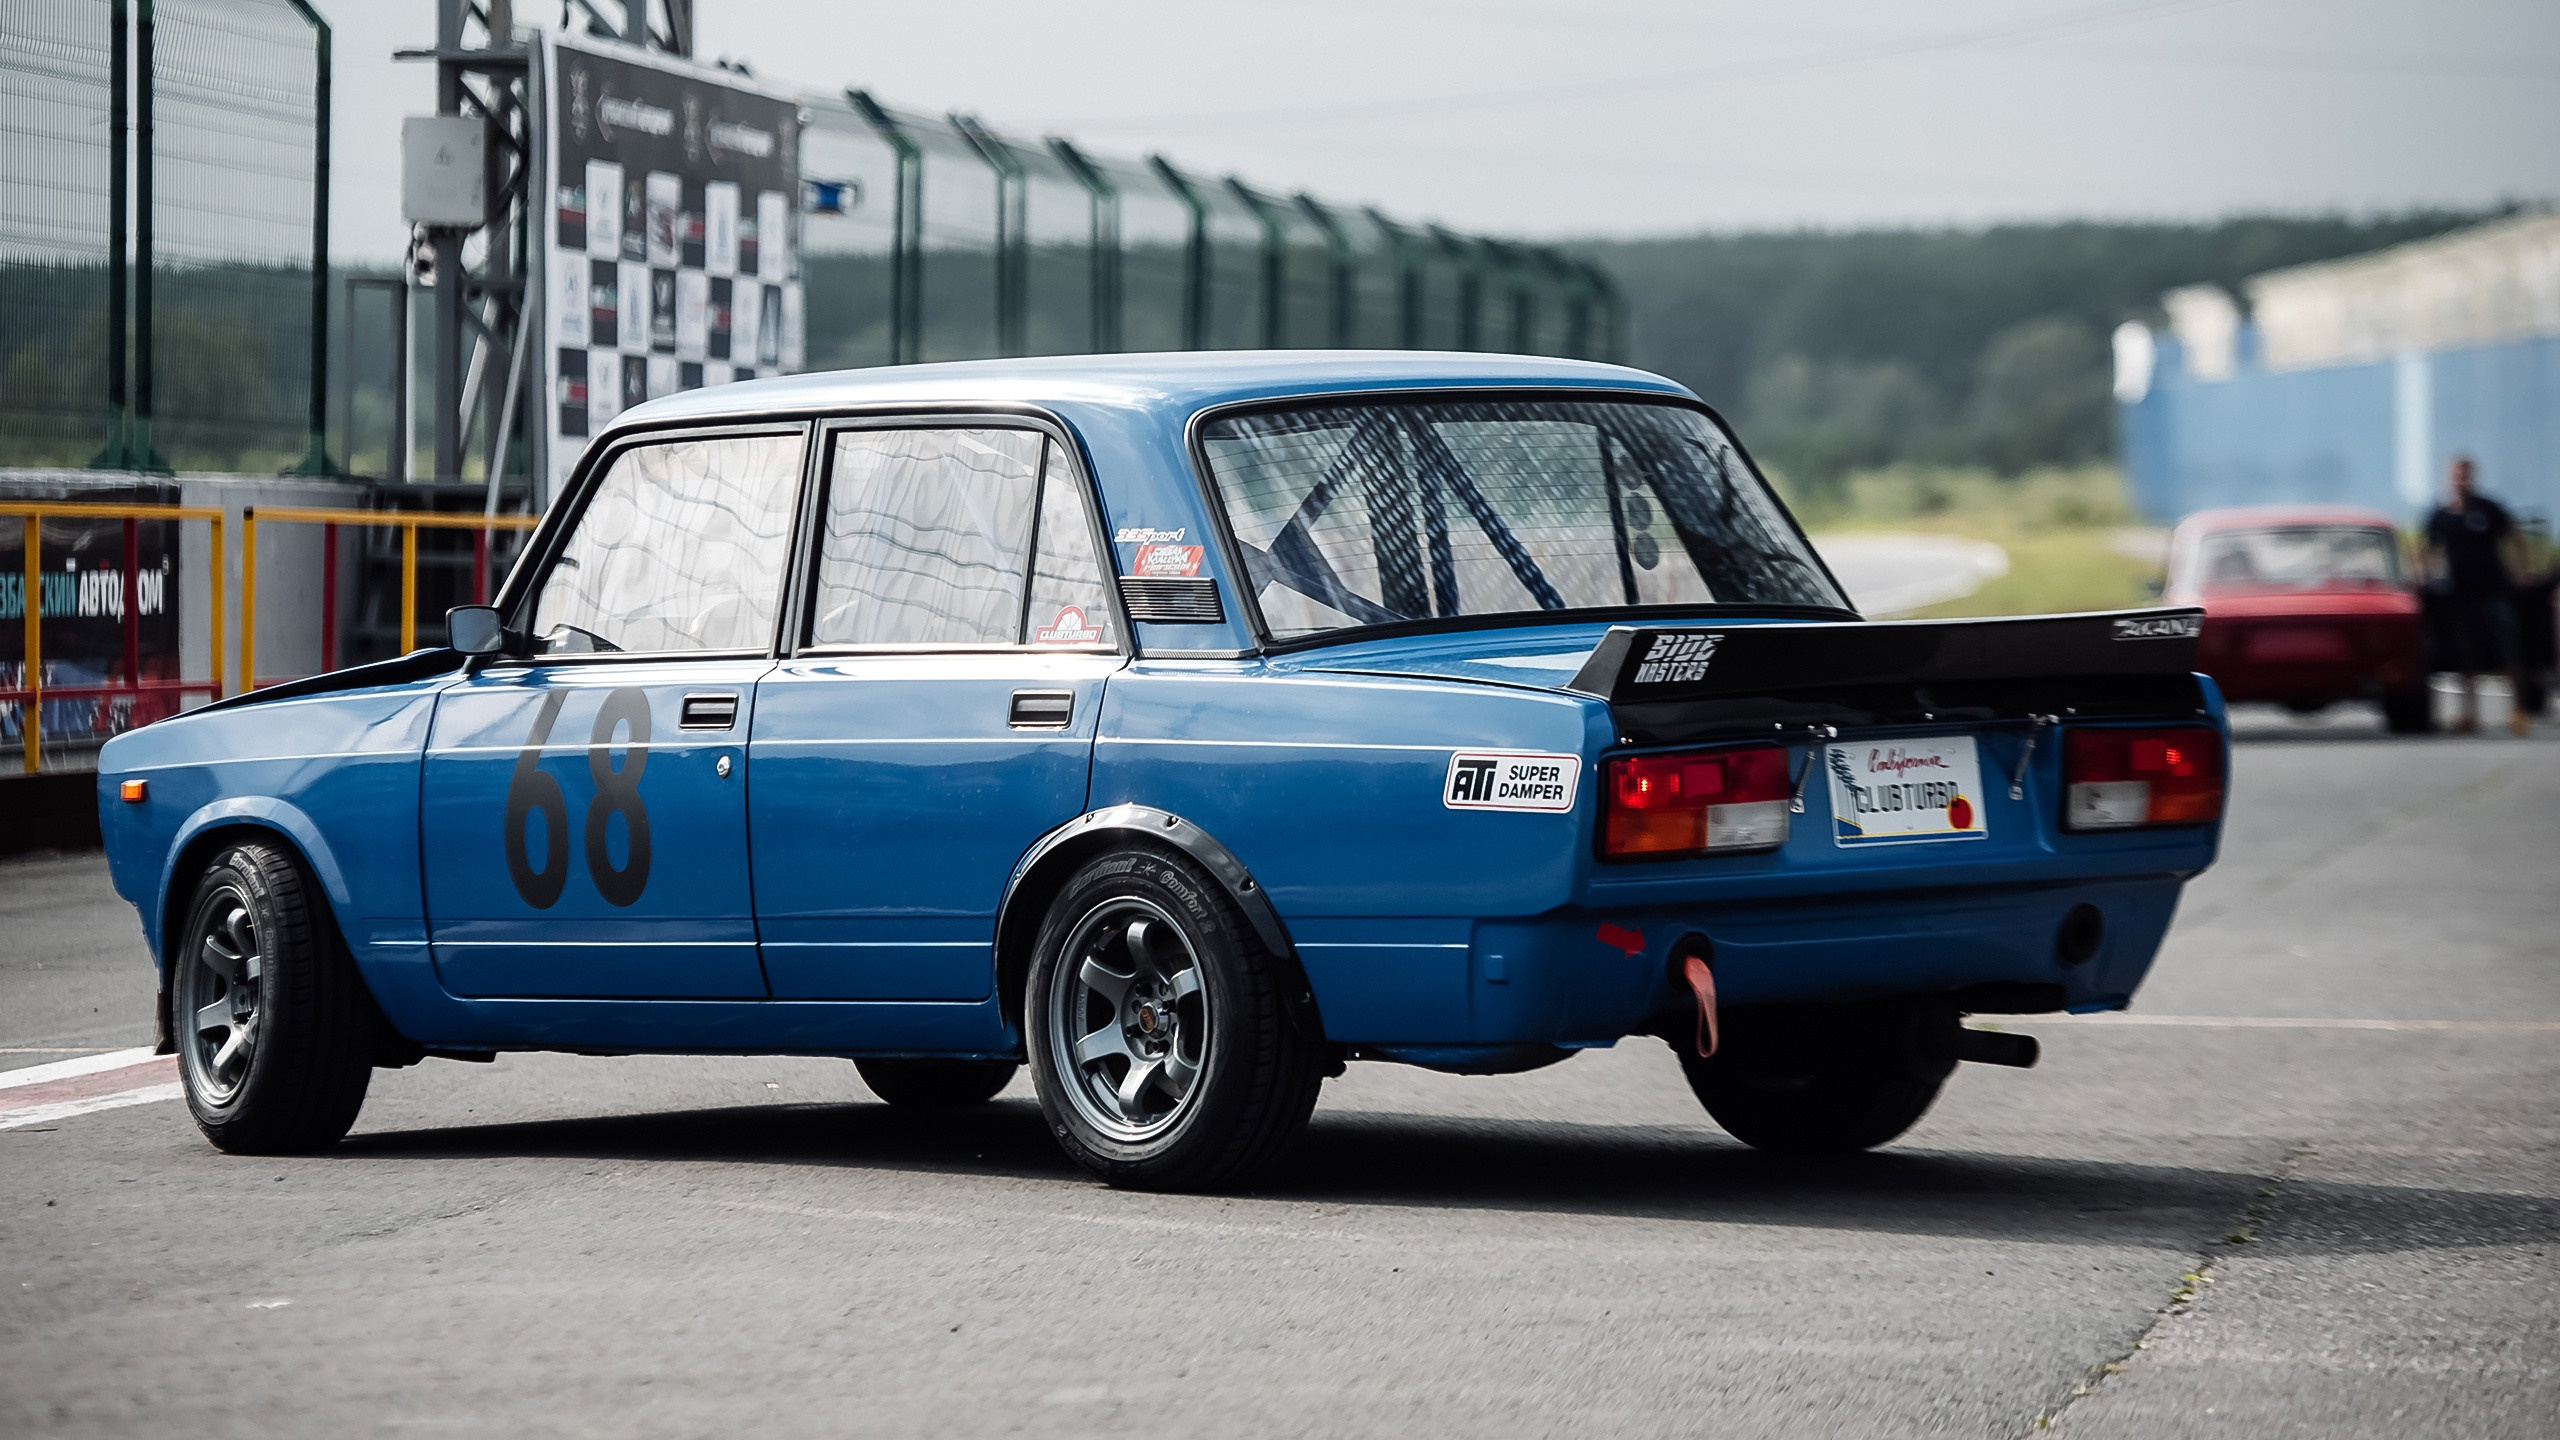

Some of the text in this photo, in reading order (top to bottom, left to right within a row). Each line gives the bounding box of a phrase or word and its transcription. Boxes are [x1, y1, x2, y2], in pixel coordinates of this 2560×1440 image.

[78, 569, 163, 624] АВТОДОМ
[1039, 629, 1098, 641] CLUBTURBO
[1644, 634, 1725, 661] SIDE
[1634, 661, 1709, 683] MASTERS
[1452, 759, 1498, 801] ATI
[1508, 765, 1560, 782] SUPER
[504, 686, 651, 910] 68
[1498, 782, 1564, 800] DAMPER
[1855, 780, 1959, 814] CLUBTURBO
[1158, 870, 1208, 921] Comfort
